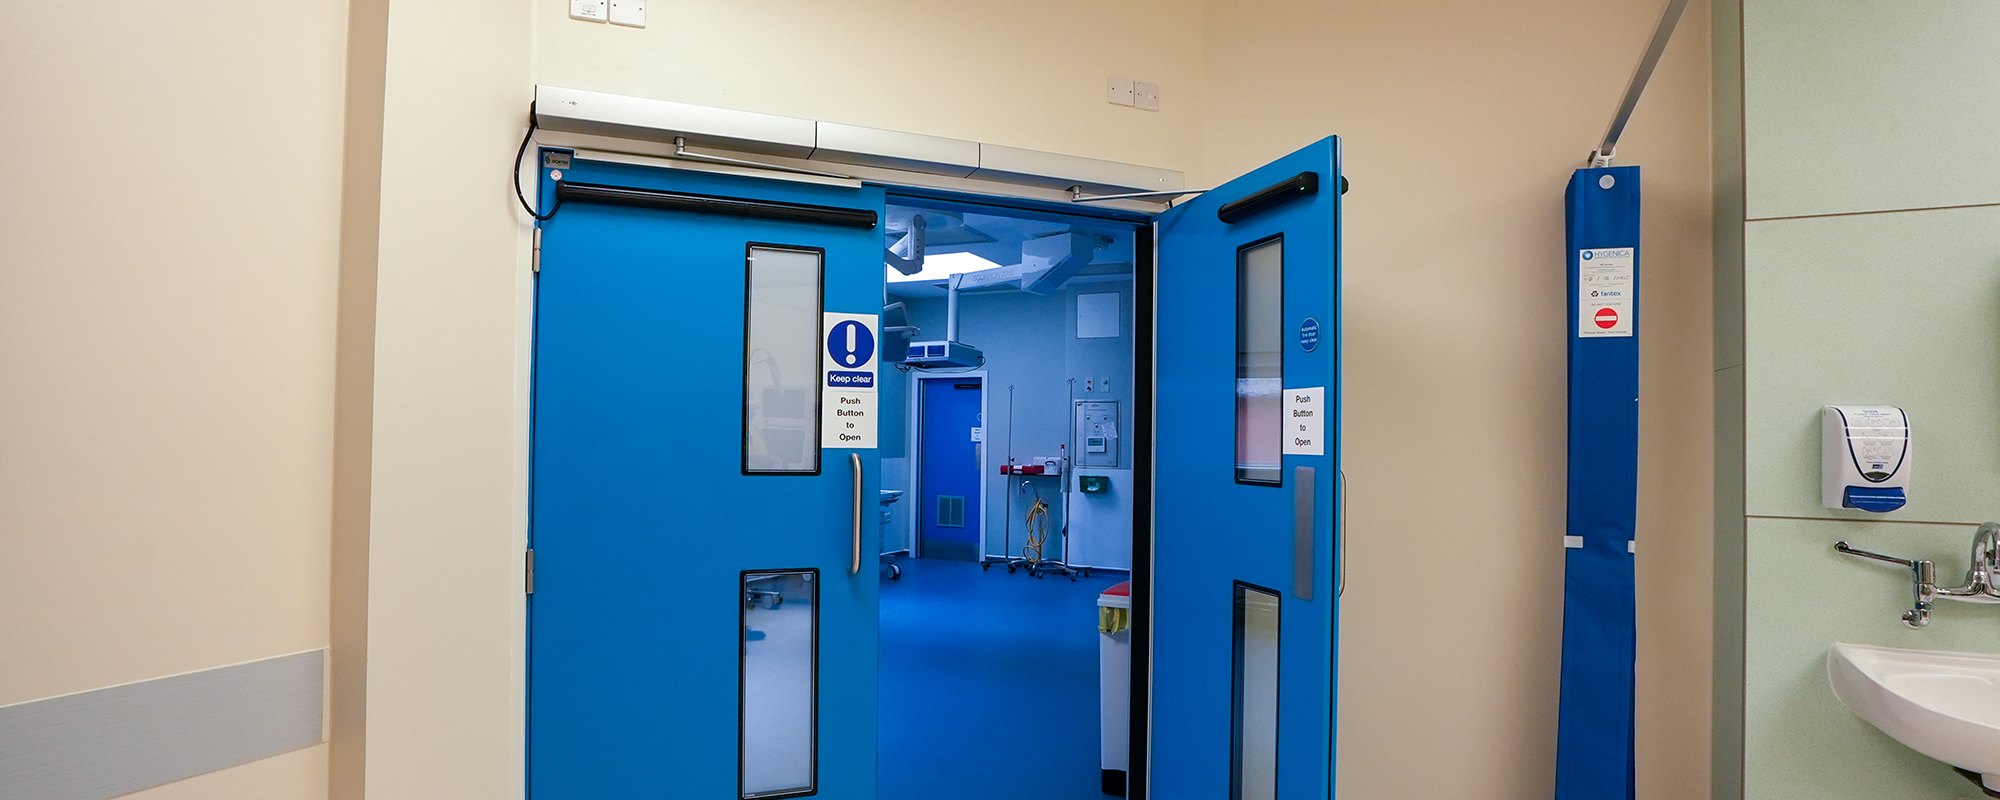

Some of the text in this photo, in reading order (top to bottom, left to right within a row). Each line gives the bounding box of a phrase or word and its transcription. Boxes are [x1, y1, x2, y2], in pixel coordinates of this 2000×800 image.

[1594, 250, 1630, 258] HYGENICA
[972, 270, 1014, 282] SCORPION 2000
[830, 374, 872, 384] Keep clear
[1296, 395, 1310, 403] Push
[1293, 409, 1313, 417] Button
[839, 433, 861, 442] Open
[1295, 438, 1311, 447] Open
